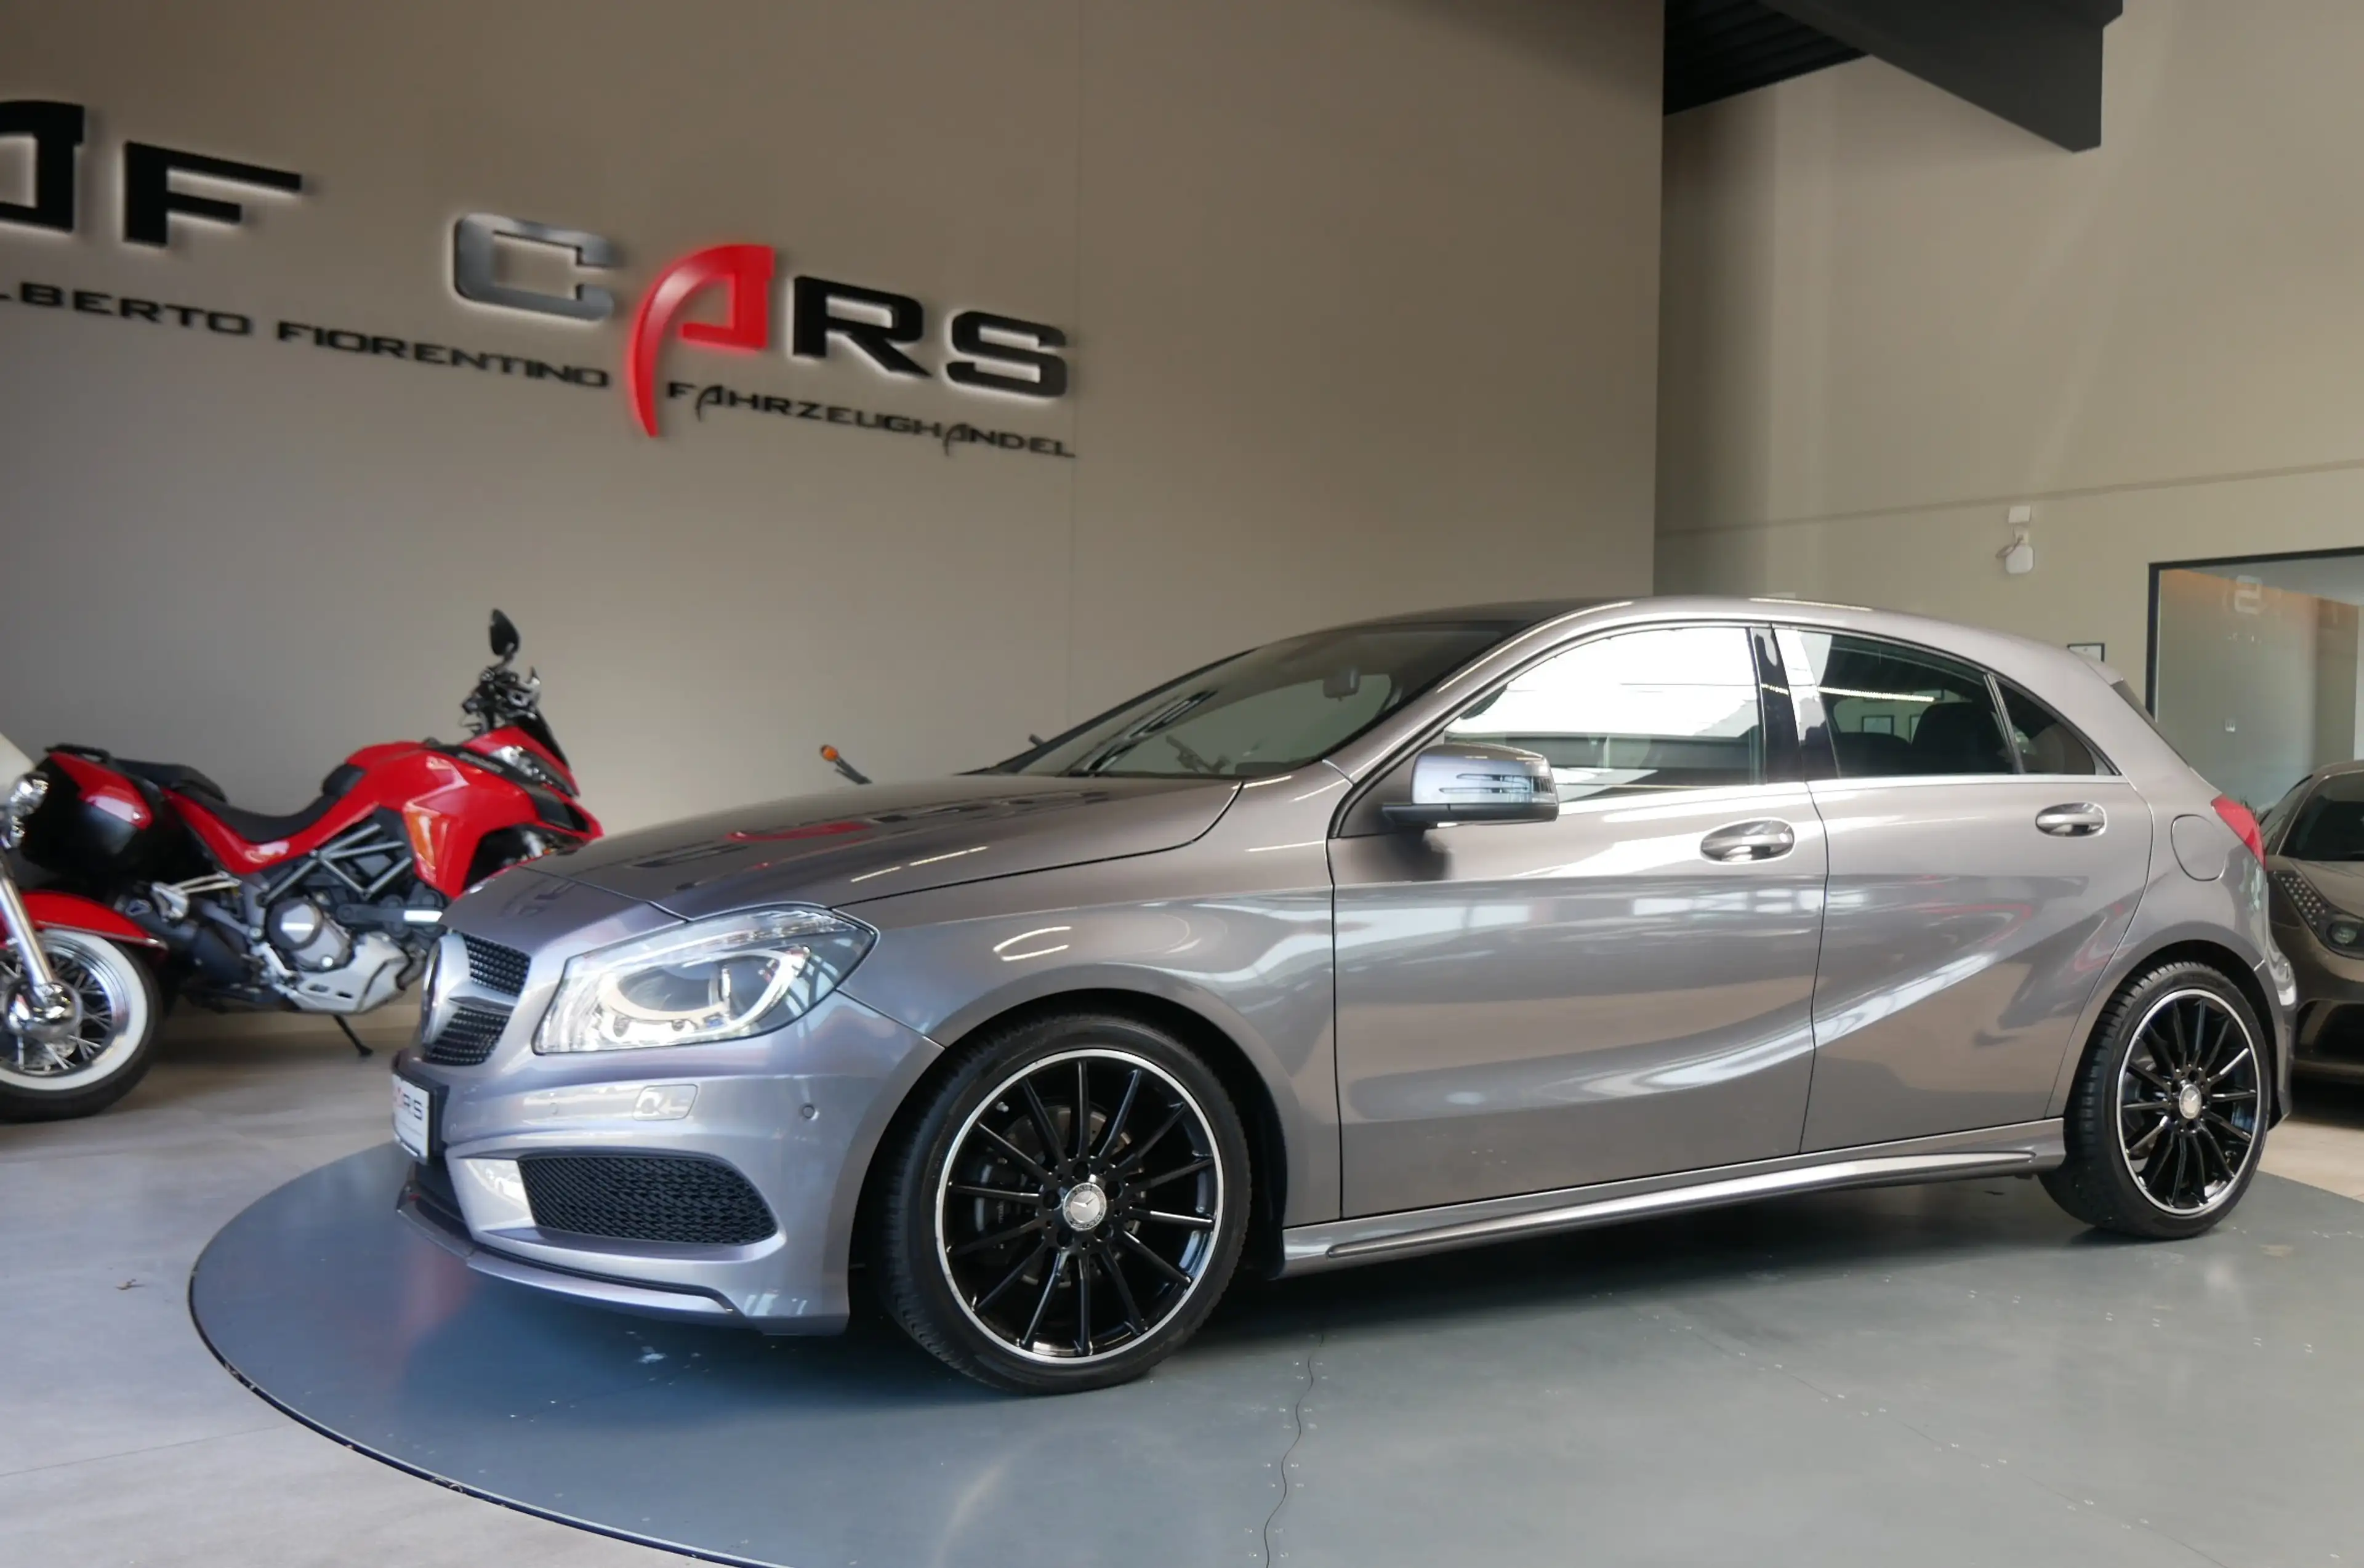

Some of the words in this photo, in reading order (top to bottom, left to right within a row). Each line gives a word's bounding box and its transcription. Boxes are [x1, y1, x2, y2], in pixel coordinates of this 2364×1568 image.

[0, 281, 252, 335] BERTO
[278, 321, 609, 388] FIORENTINO
[667, 382, 1076, 457] FAHRZEUGHANDEL
[454, 212, 1067, 438] CARS
